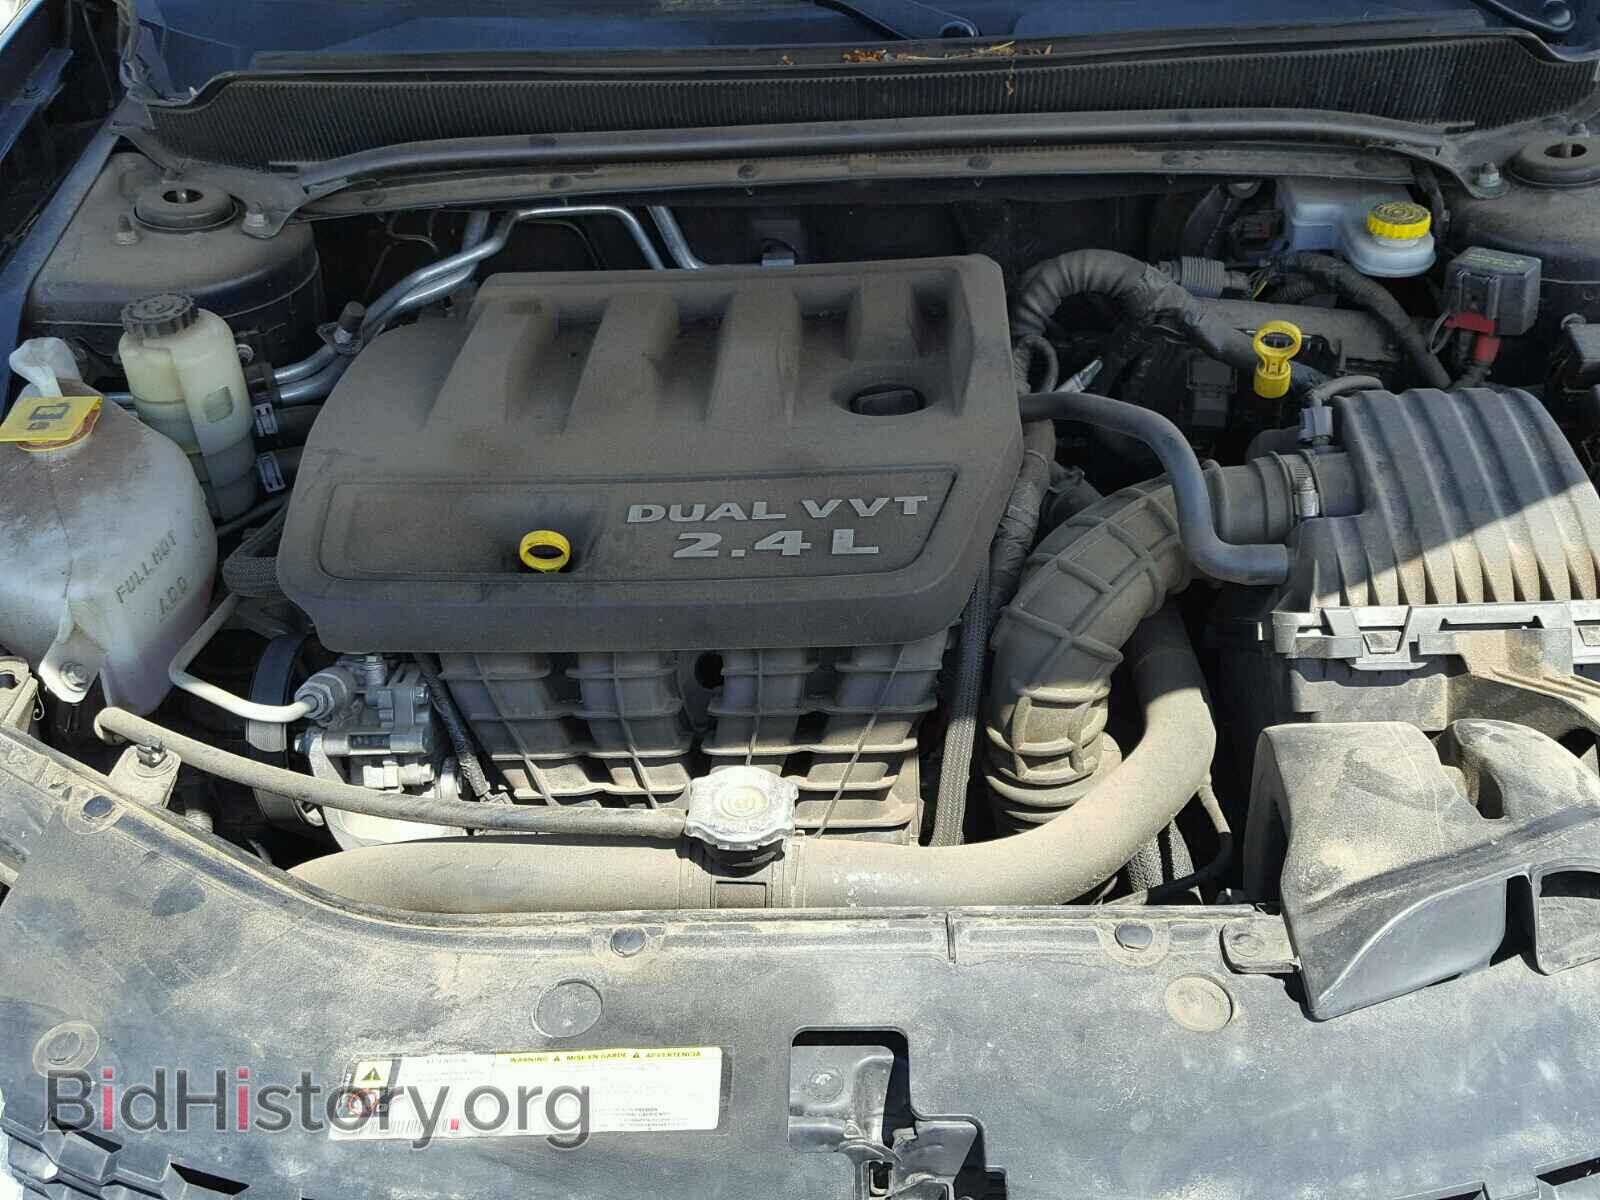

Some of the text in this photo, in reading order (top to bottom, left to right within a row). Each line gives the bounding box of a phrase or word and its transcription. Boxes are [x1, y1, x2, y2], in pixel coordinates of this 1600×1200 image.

[626, 495, 929, 524] DUAL VVT
[116, 561, 153, 604] FULL
